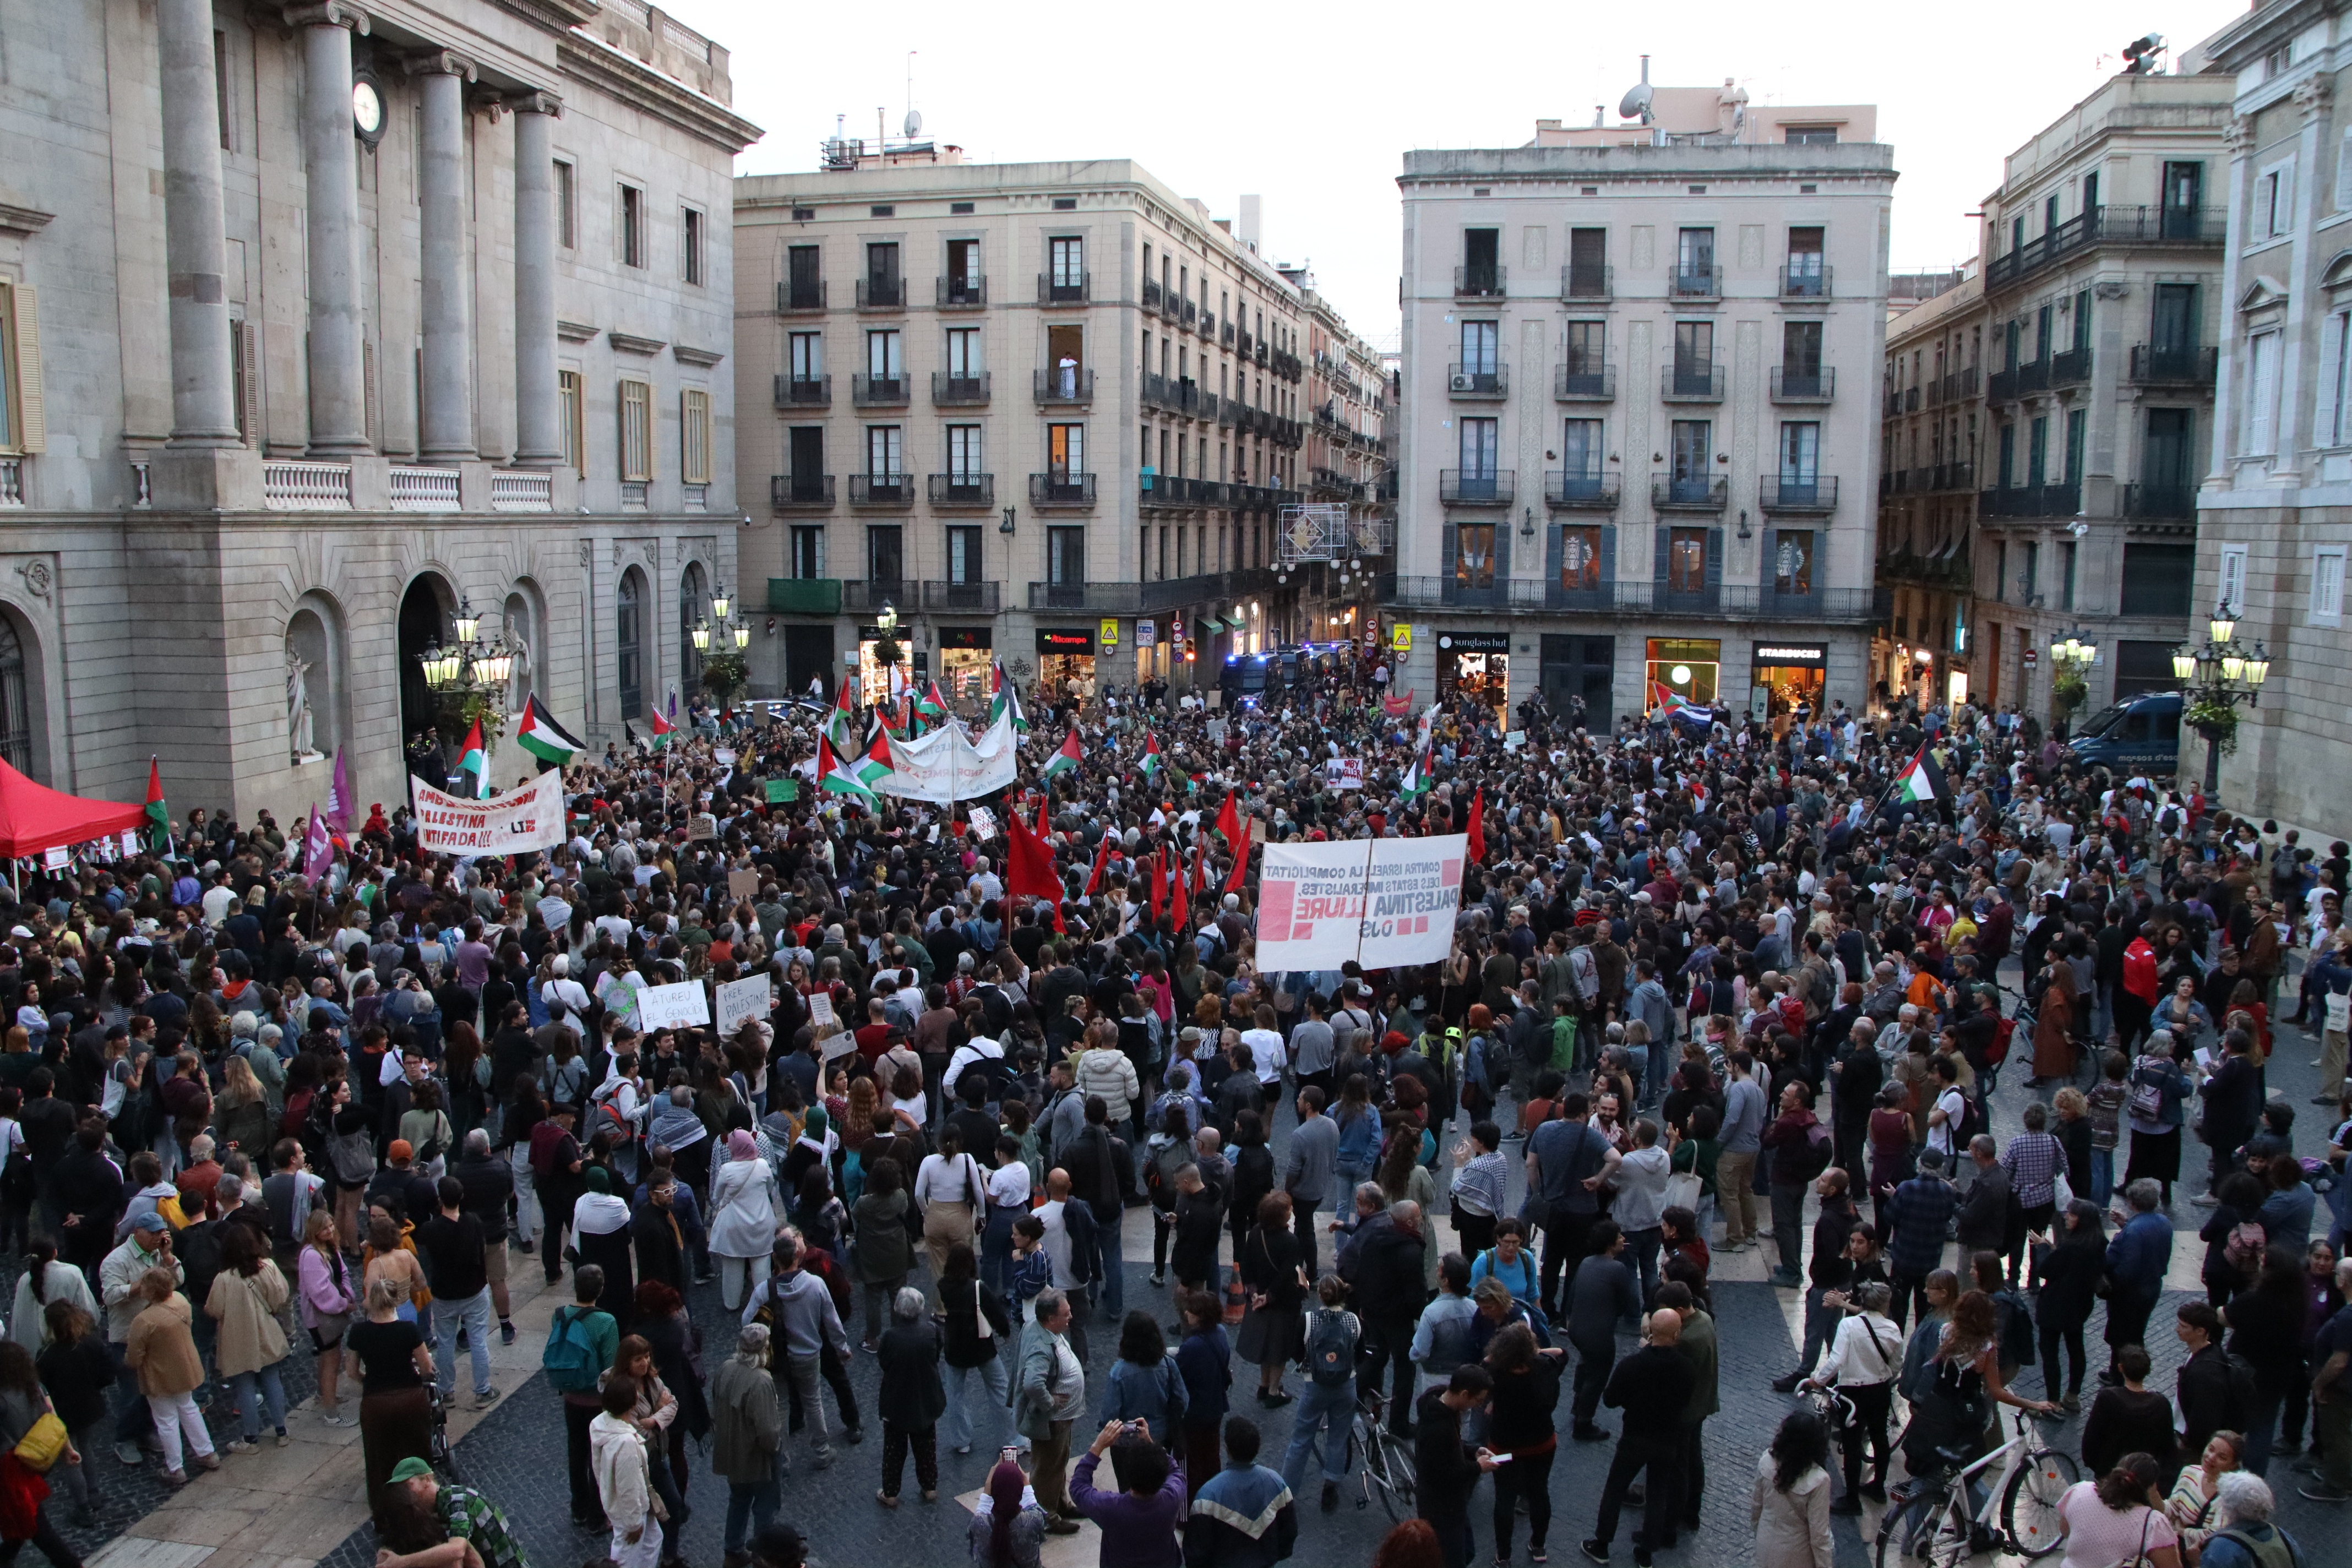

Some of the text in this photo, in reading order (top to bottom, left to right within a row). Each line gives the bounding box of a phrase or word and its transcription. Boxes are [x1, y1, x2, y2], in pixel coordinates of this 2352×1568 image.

[1454, 638, 1506, 649] sunglass hut
[1758, 648, 1821, 658] STARBUCKS
[1344, 760, 1359, 769] BABY
[1342, 769, 1362, 781] KILLER
[651, 990, 691, 1006] ATUREU
[723, 986, 743, 1002] FREE
[726, 990, 767, 1019] PALESTINE
[646, 1012, 659, 1022] EL
